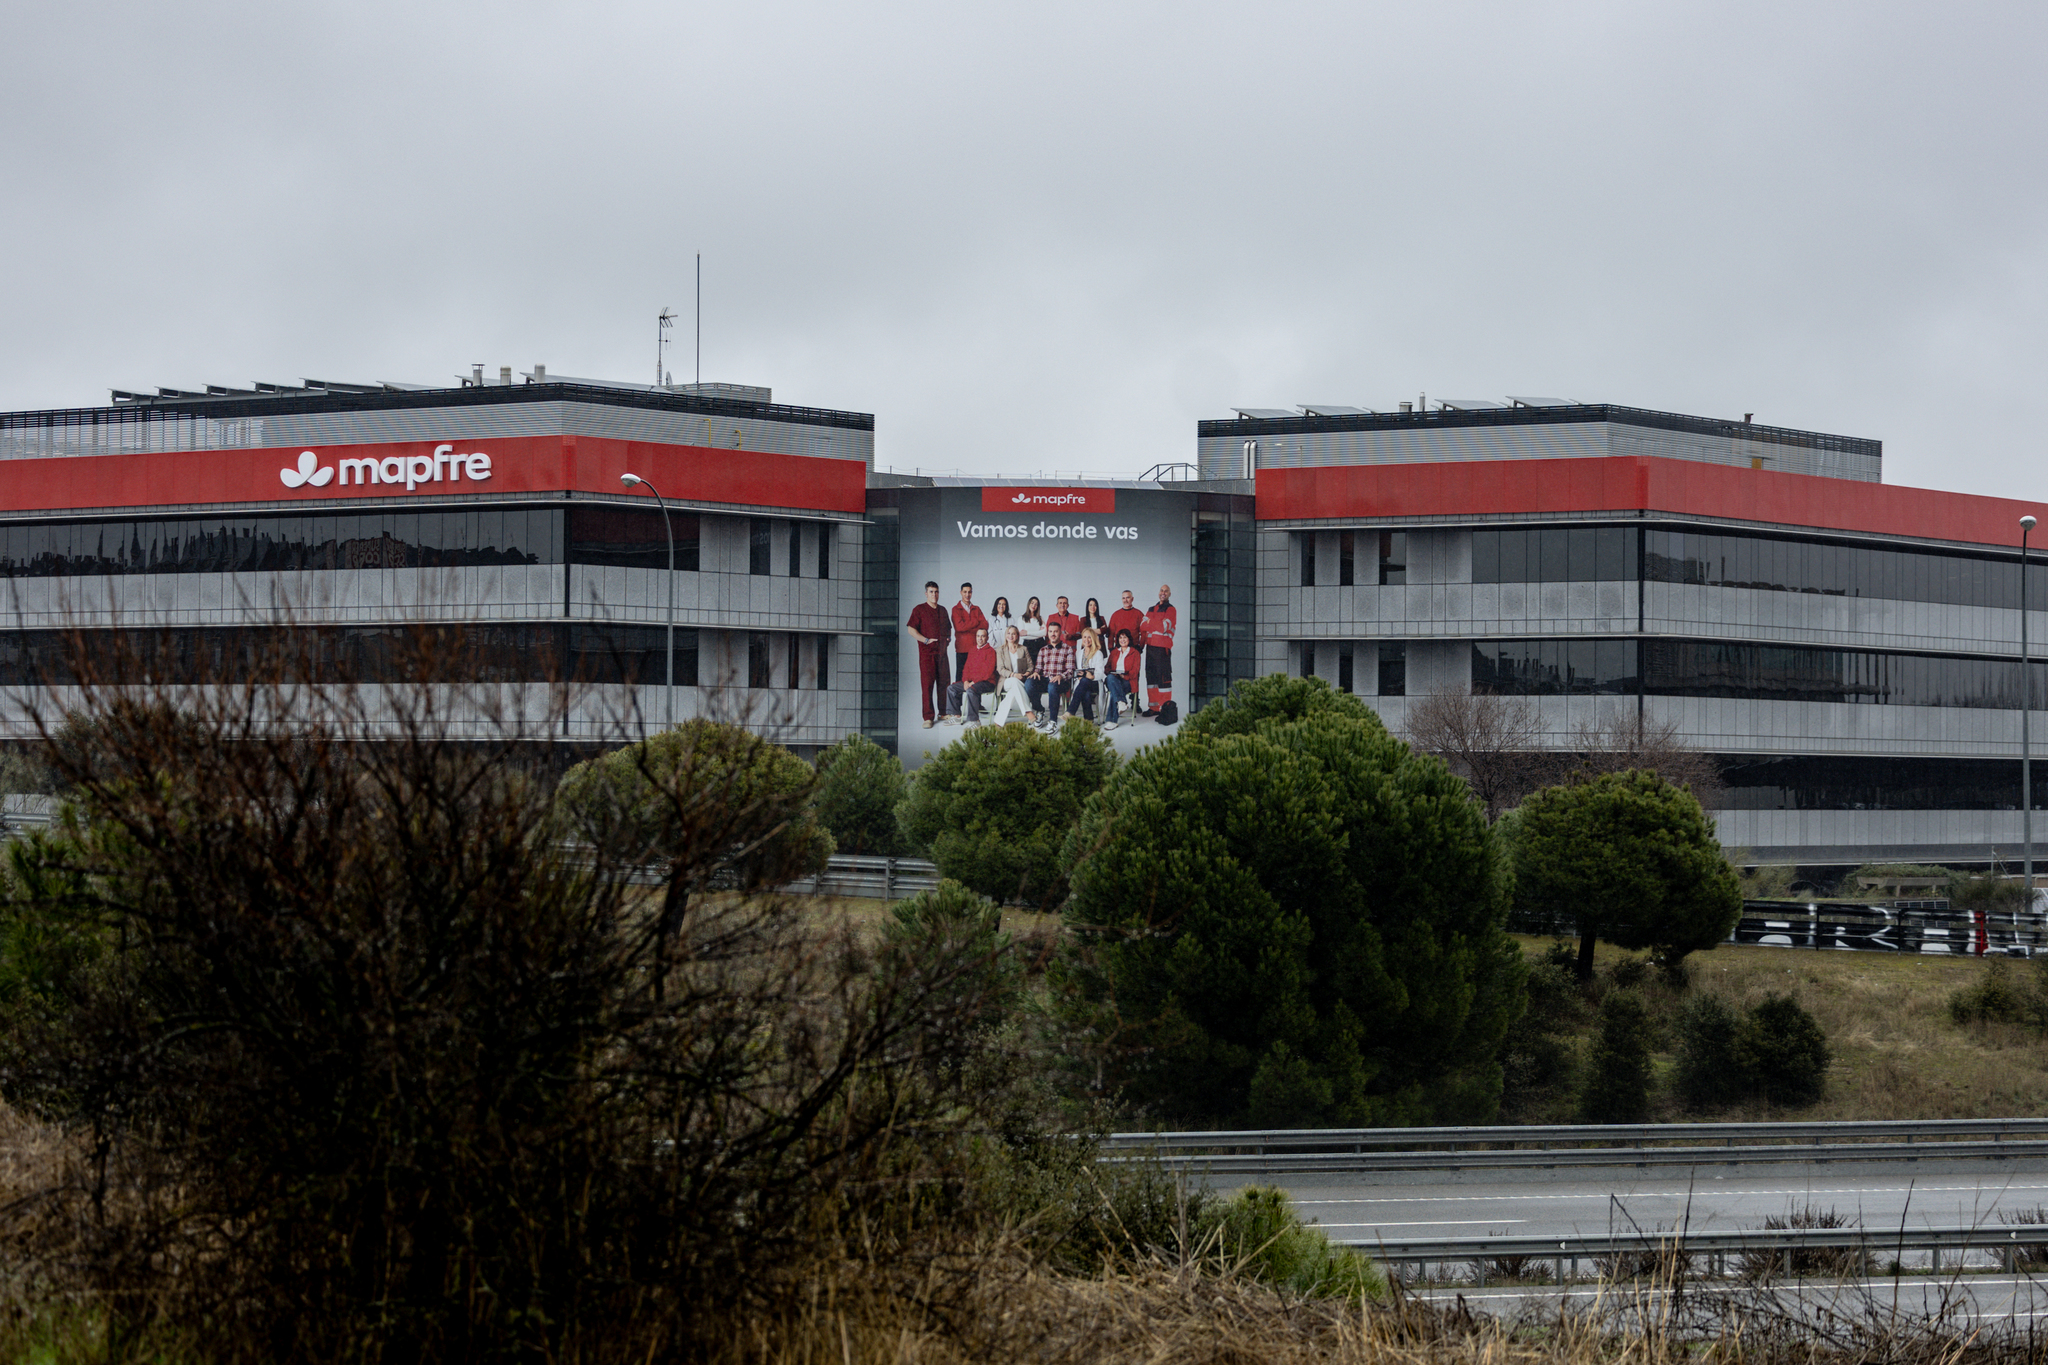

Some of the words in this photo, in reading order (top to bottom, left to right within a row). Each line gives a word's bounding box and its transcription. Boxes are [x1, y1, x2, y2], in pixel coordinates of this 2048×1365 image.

[339, 444, 492, 491] mapfre
[1033, 493, 1086, 506] mapfre
[957, 521, 1028, 538] Vamos
[1032, 521, 1098, 539] donde
[1104, 526, 1139, 540] vas
